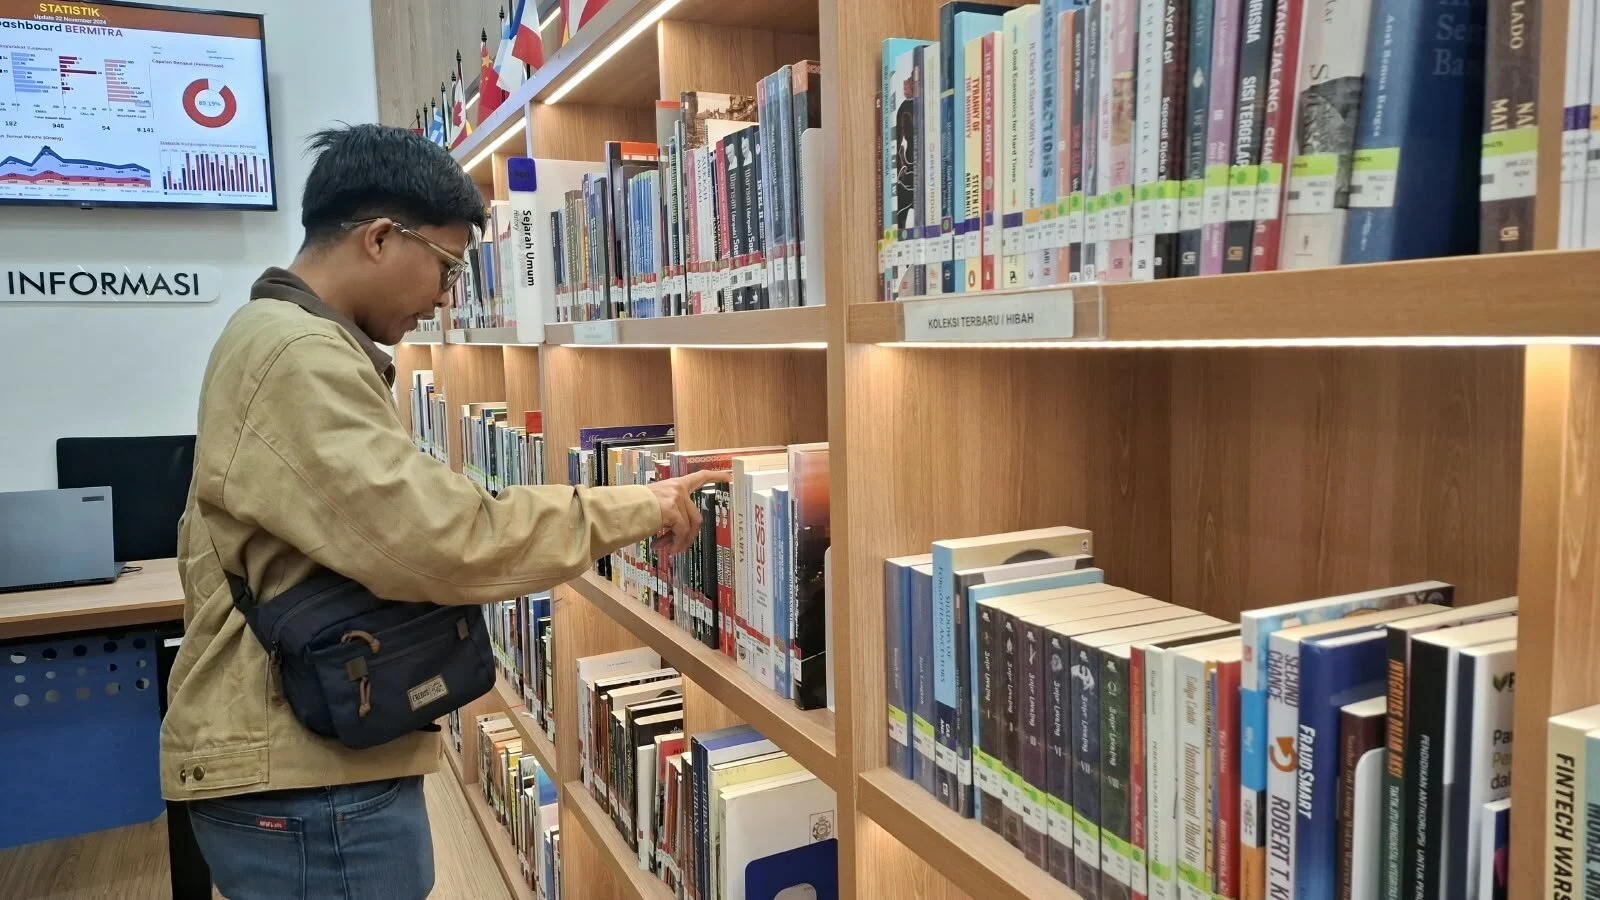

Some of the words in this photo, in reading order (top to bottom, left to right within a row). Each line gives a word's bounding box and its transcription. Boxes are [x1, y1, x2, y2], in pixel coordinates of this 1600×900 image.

[40, 3, 100, 17] STATISTIK
[64, 16, 92, 24] November
[1273, 0, 1288, 48] TANG
[65, 25, 123, 37] BERMITRA
[1383, 14, 1395, 47] Anak
[984, 50, 993, 72] THE
[1163, 41, 1174, 64] Api
[971, 77, 981, 119] TYRANNY
[984, 74, 993, 105] PRICE
[1241, 76, 1257, 101] SISI
[1267, 52, 1283, 113] JALANG
[972, 120, 981, 133] OF
[984, 106, 993, 121] OF
[1160, 96, 1171, 140] Sapardi
[1372, 94, 1387, 137] Bangsa
[984, 124, 993, 165] MONEY
[1158, 141, 1169, 173] Djoko
[730, 173, 738, 210] Warisan
[744, 168, 753, 207] Warisan
[971, 174, 980, 205] STEVEN
[513, 209, 521, 232] History
[521, 209, 535, 250] Sejarah
[8, 270, 199, 296] INFORMASI
[525, 251, 536, 286] Umum
[928, 318, 960, 330] KOLEKSI
[961, 315, 1000, 327] TERBARU
[1006, 312, 1035, 325] HIBAH
[1267, 649, 1285, 704] CHANCE
[1284, 654, 1300, 709] SECOND
[1388, 659, 1405, 718] INTEGRITAS
[1388, 718, 1404, 753] DALAM
[1388, 753, 1403, 779] AKSI
[1418, 734, 1431, 789] PENDIDIKAN
[1389, 785, 1400, 808] TAKTIK
[1555, 752, 1576, 841] FINTECH
[1271, 794, 1291, 866] ROBERT
[1389, 807, 1399, 821] JITU
[1417, 789, 1428, 847] ANTIKORUPSI
[1271, 866, 1290, 878] T.
[1415, 849, 1426, 881] UNTUK
[1553, 845, 1574, 900] WARS
